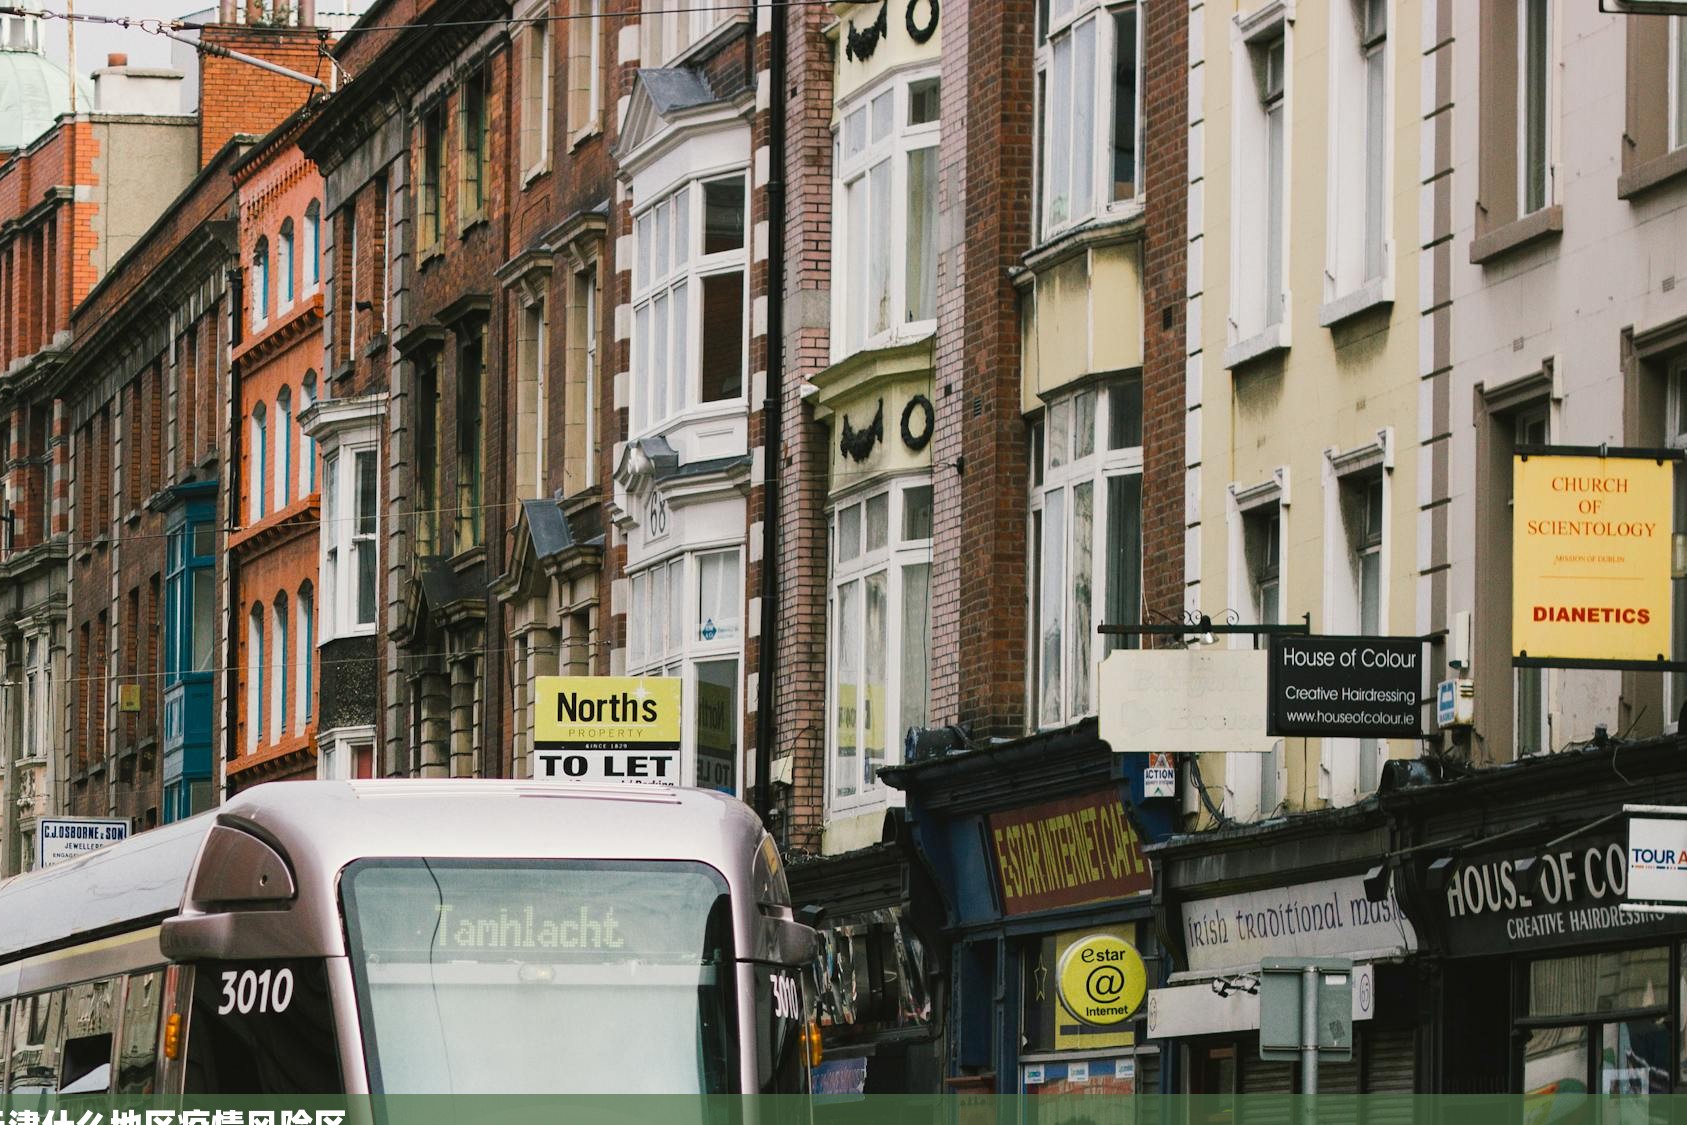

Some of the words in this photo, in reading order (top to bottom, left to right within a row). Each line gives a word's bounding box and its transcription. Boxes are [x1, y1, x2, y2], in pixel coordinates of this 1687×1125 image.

[1552, 477, 1628, 493] CHURCH
[650, 491, 666, 536] 68
[1578, 499, 1602, 514] OF
[1528, 520, 1656, 537] SCIENTOLOGY
[1555, 554, 1586, 562] MISSION
[1597, 555, 1625, 564] DUBLIN
[1533, 606, 1650, 625] DIANETICS
[1283, 647, 1335, 668] House
[1339, 648, 1357, 669] of
[1361, 648, 1416, 669] Colour
[1285, 686, 1339, 702] Creative
[1341, 687, 1415, 706] Hairdressing
[557, 692, 658, 723] Norths
[1287, 709, 1414, 726] www.houseofcolour.ie
[568, 728, 645, 738] PROPERTY
[539, 755, 589, 777] TO
[604, 755, 673, 777] LET
[1145, 769, 1174, 779] ACTION
[1037, 806, 1106, 891] INTERNET
[1100, 801, 1145, 879] CAFE
[1631, 848, 1675, 865] TOUR
[1677, 850, 1687, 865] A
[1540, 851, 1576, 905] OF
[1584, 843, 1627, 899] CO
[434, 904, 625, 947] Tamhlacht
[1507, 912, 1565, 940] CREATIVE
[217, 967, 294, 1015] 3010
[769, 974, 799, 1020] 3010
[1085, 1004, 1129, 1017] Internet
